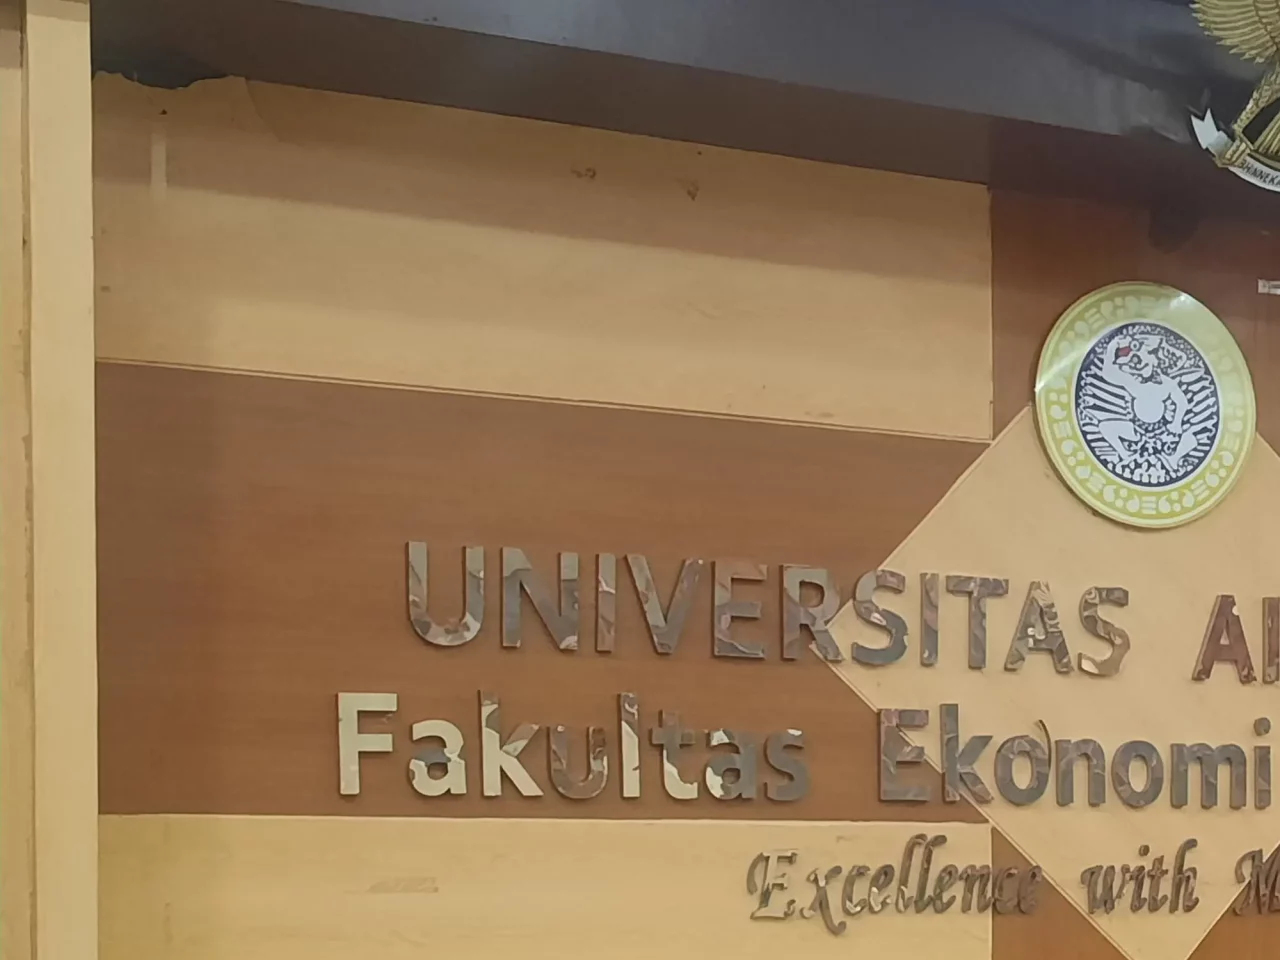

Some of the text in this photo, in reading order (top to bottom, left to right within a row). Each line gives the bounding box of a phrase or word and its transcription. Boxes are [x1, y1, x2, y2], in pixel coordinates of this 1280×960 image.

[406, 541, 1131, 677] UNIVERSITAS
[336, 690, 811, 801] Fakultas
[877, 703, 1272, 810] Ekonomi
[746, 833, 1043, 936] Excellence
[1080, 838, 1200, 915] with
